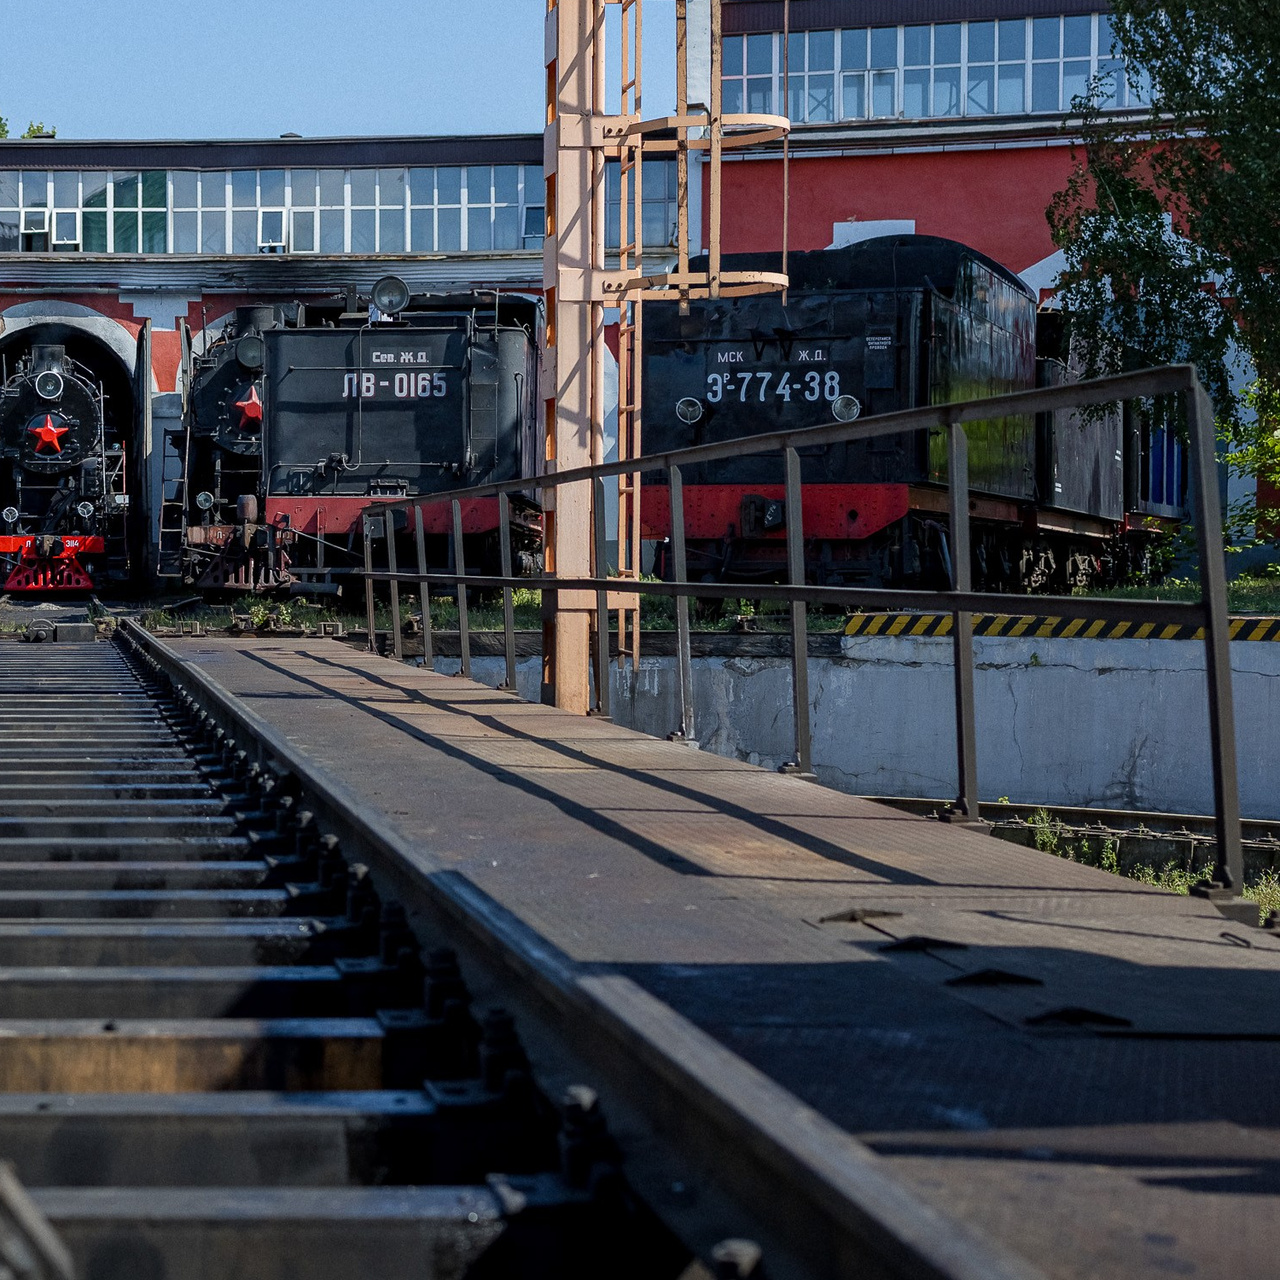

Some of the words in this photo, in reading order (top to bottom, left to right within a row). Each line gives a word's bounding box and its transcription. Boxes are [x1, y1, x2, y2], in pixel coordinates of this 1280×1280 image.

[372, 351, 397, 363] Сев.
[400, 351, 430, 363] Ж.Д.
[717, 351, 744, 363] МСК
[798, 349, 827, 361] Ж.Д.
[342, 372, 447, 398] ЛВ-0165
